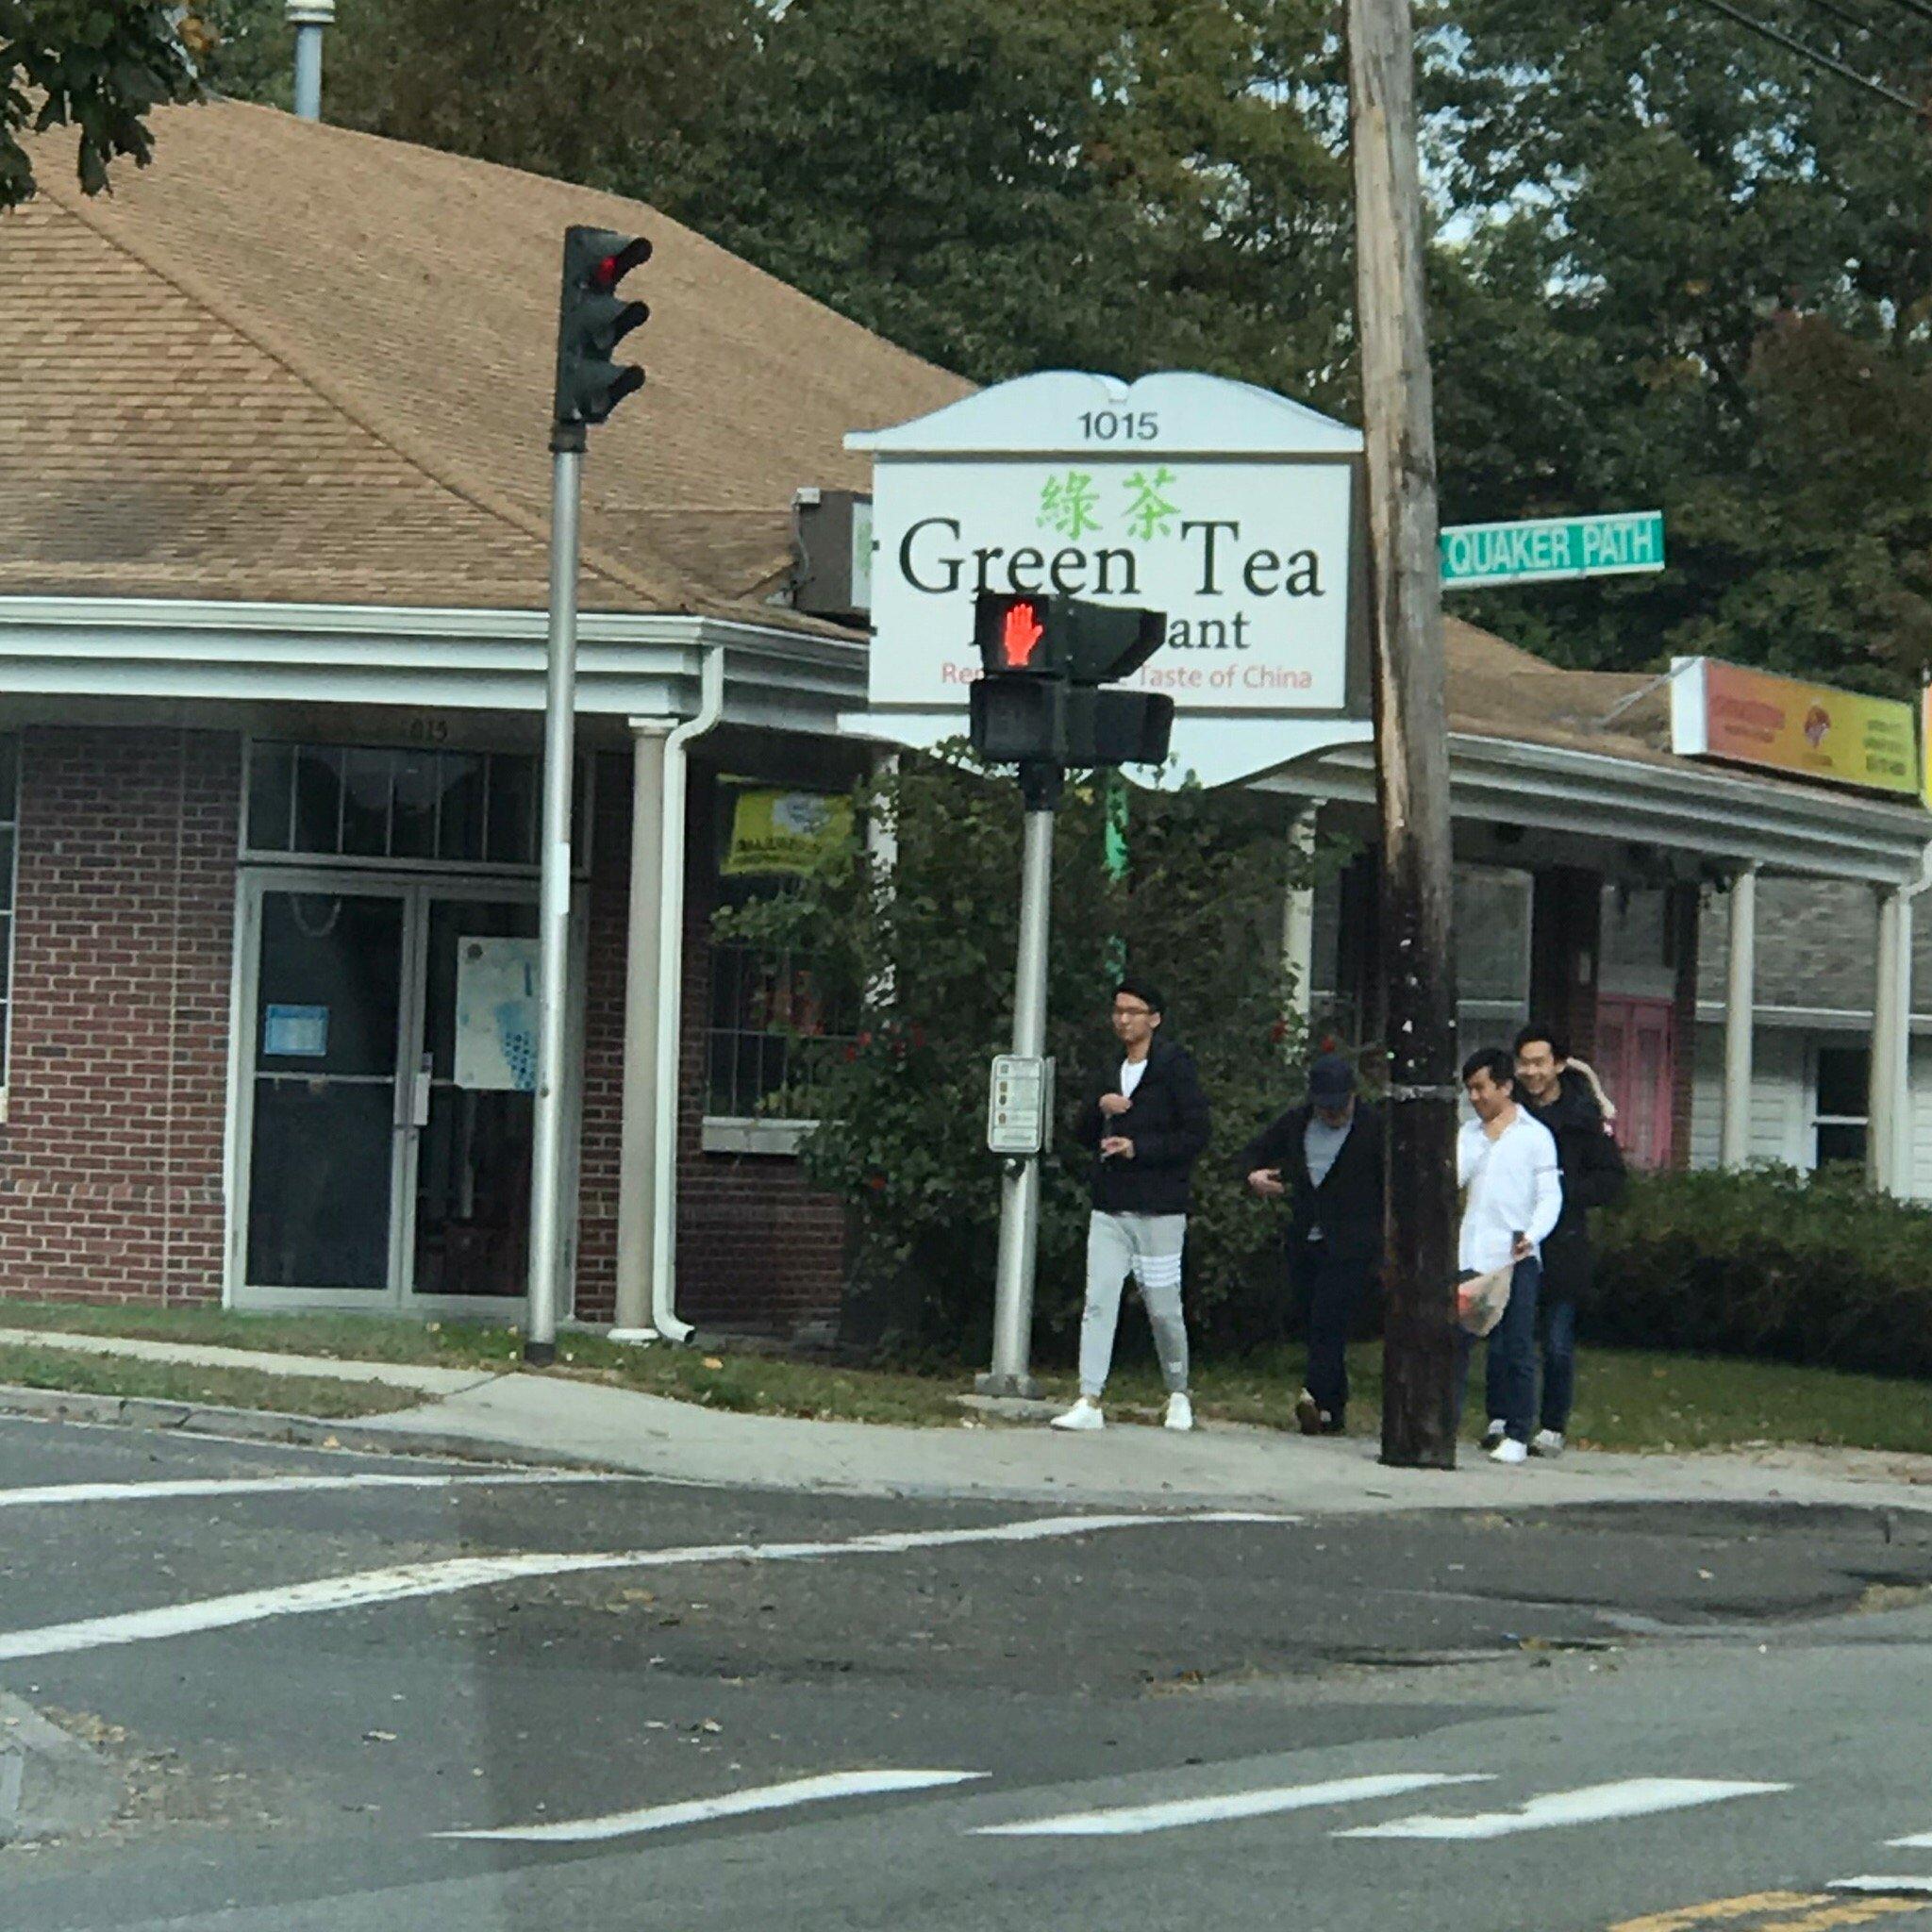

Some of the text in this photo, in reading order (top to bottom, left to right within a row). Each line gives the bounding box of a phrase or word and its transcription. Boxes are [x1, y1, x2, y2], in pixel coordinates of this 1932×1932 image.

[1077, 410, 1159, 441] 1015
[899, 517, 1325, 596] Green Tea
[1447, 521, 1653, 575] QUAKER PATH
[1139, 663, 1313, 690] Taste of China
